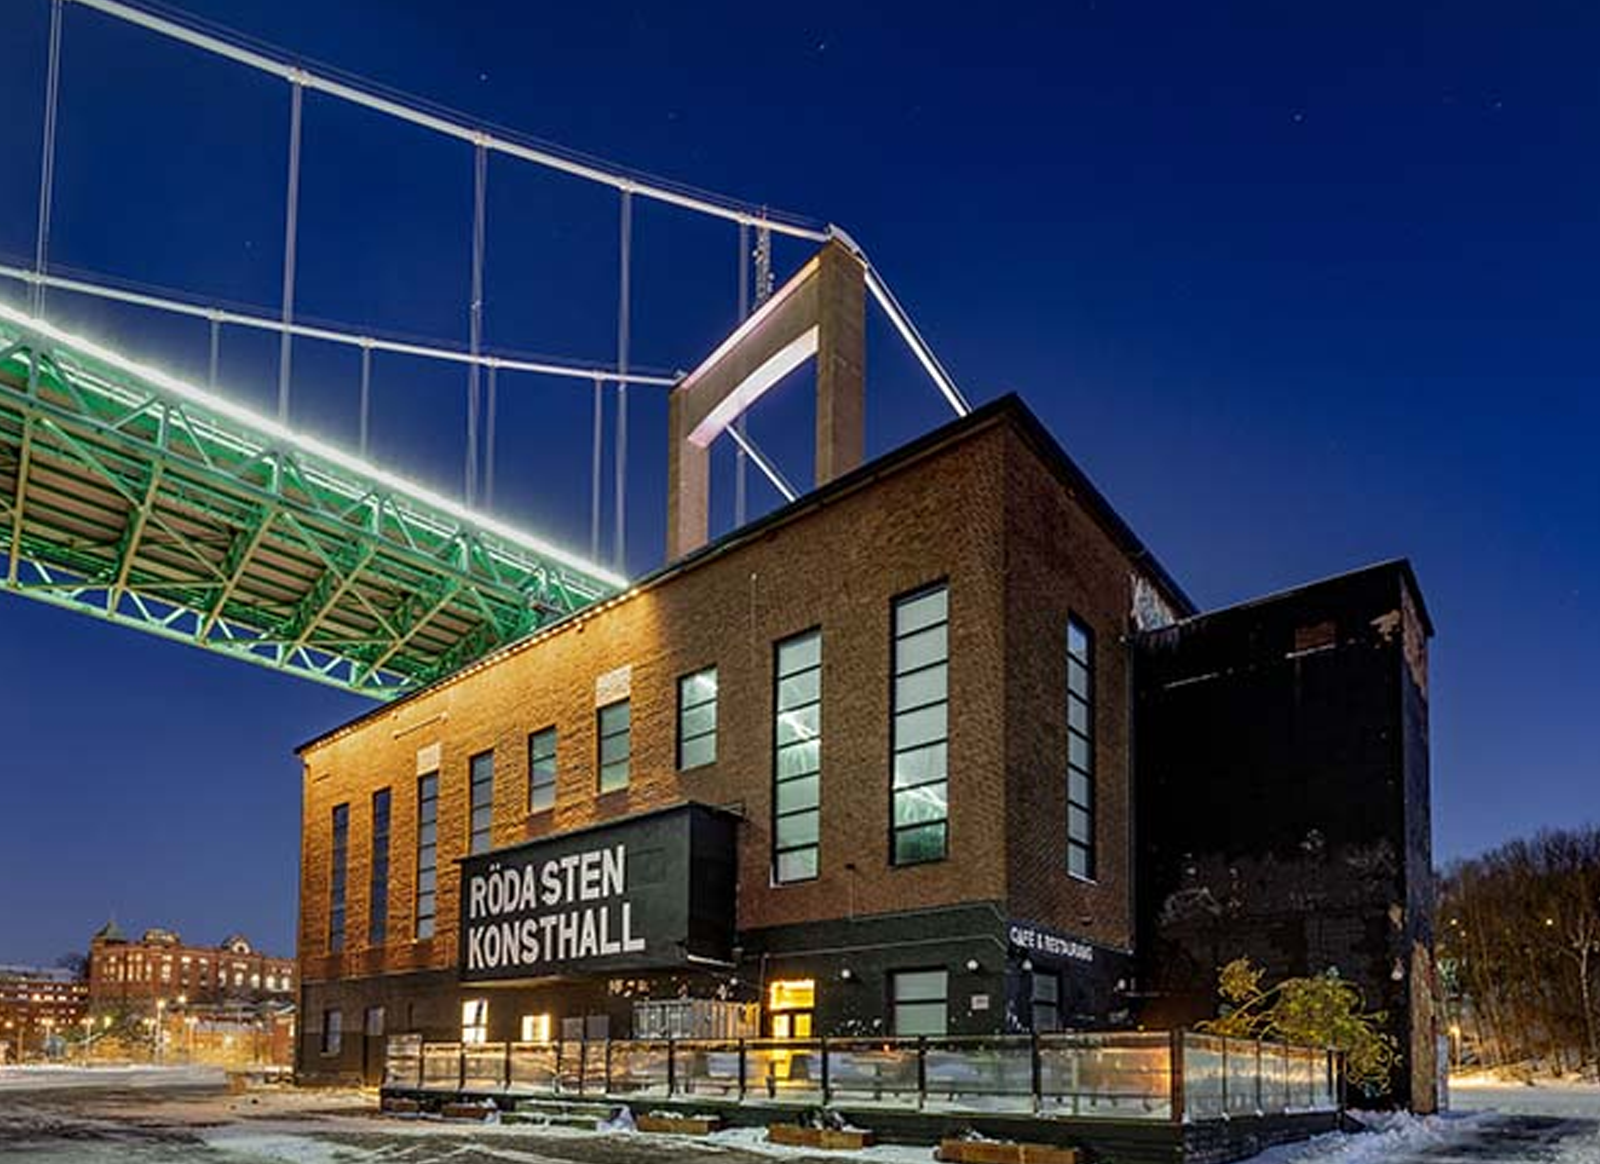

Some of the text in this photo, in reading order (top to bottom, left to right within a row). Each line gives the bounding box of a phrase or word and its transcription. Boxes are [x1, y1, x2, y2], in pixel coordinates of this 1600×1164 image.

[469, 844, 626, 919] RÖDA STEN
[467, 902, 646, 970] KONSTHALL
